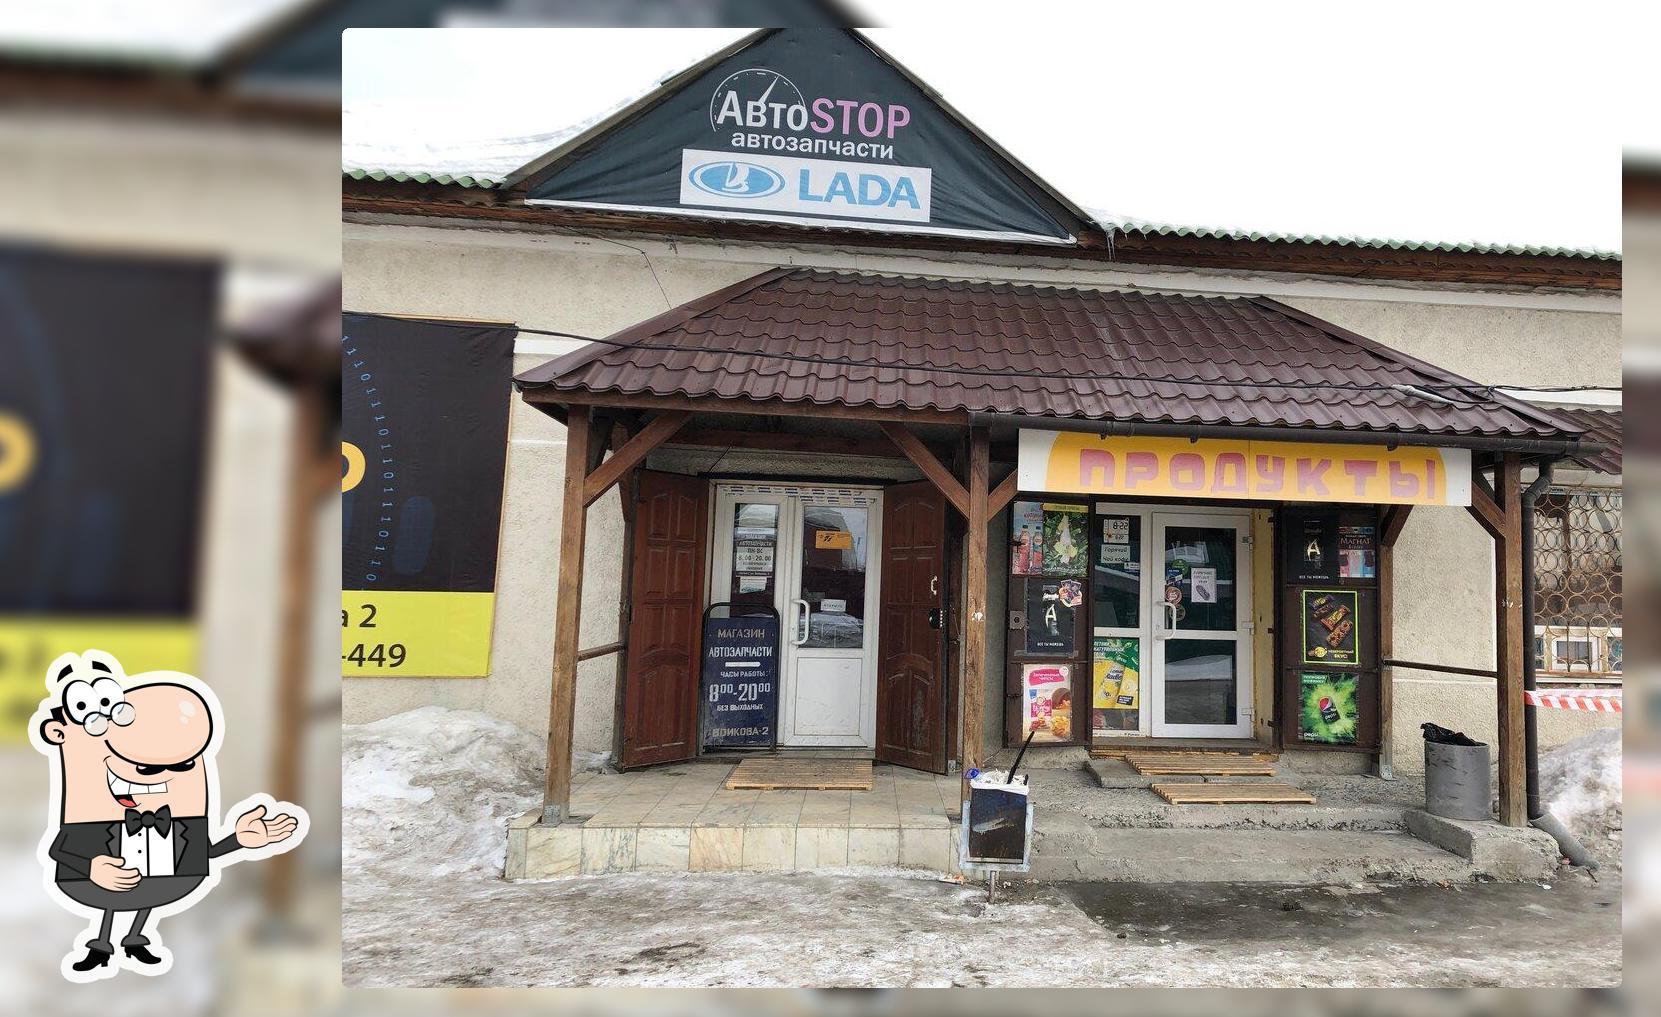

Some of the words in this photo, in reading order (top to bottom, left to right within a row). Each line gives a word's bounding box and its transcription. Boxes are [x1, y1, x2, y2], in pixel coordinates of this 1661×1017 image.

[731, 131, 894, 160] автозапчасти
[798, 168, 921, 210] LADA
[1079, 448, 1436, 499] ПРОДУКТЫ
[359, 604, 377, 628] 2
[718, 629, 765, 639] МАГАЗИН
[708, 646, 773, 658] АВТОЗАПЧАСТИ
[717, 704, 729, 712] БЕЗ
